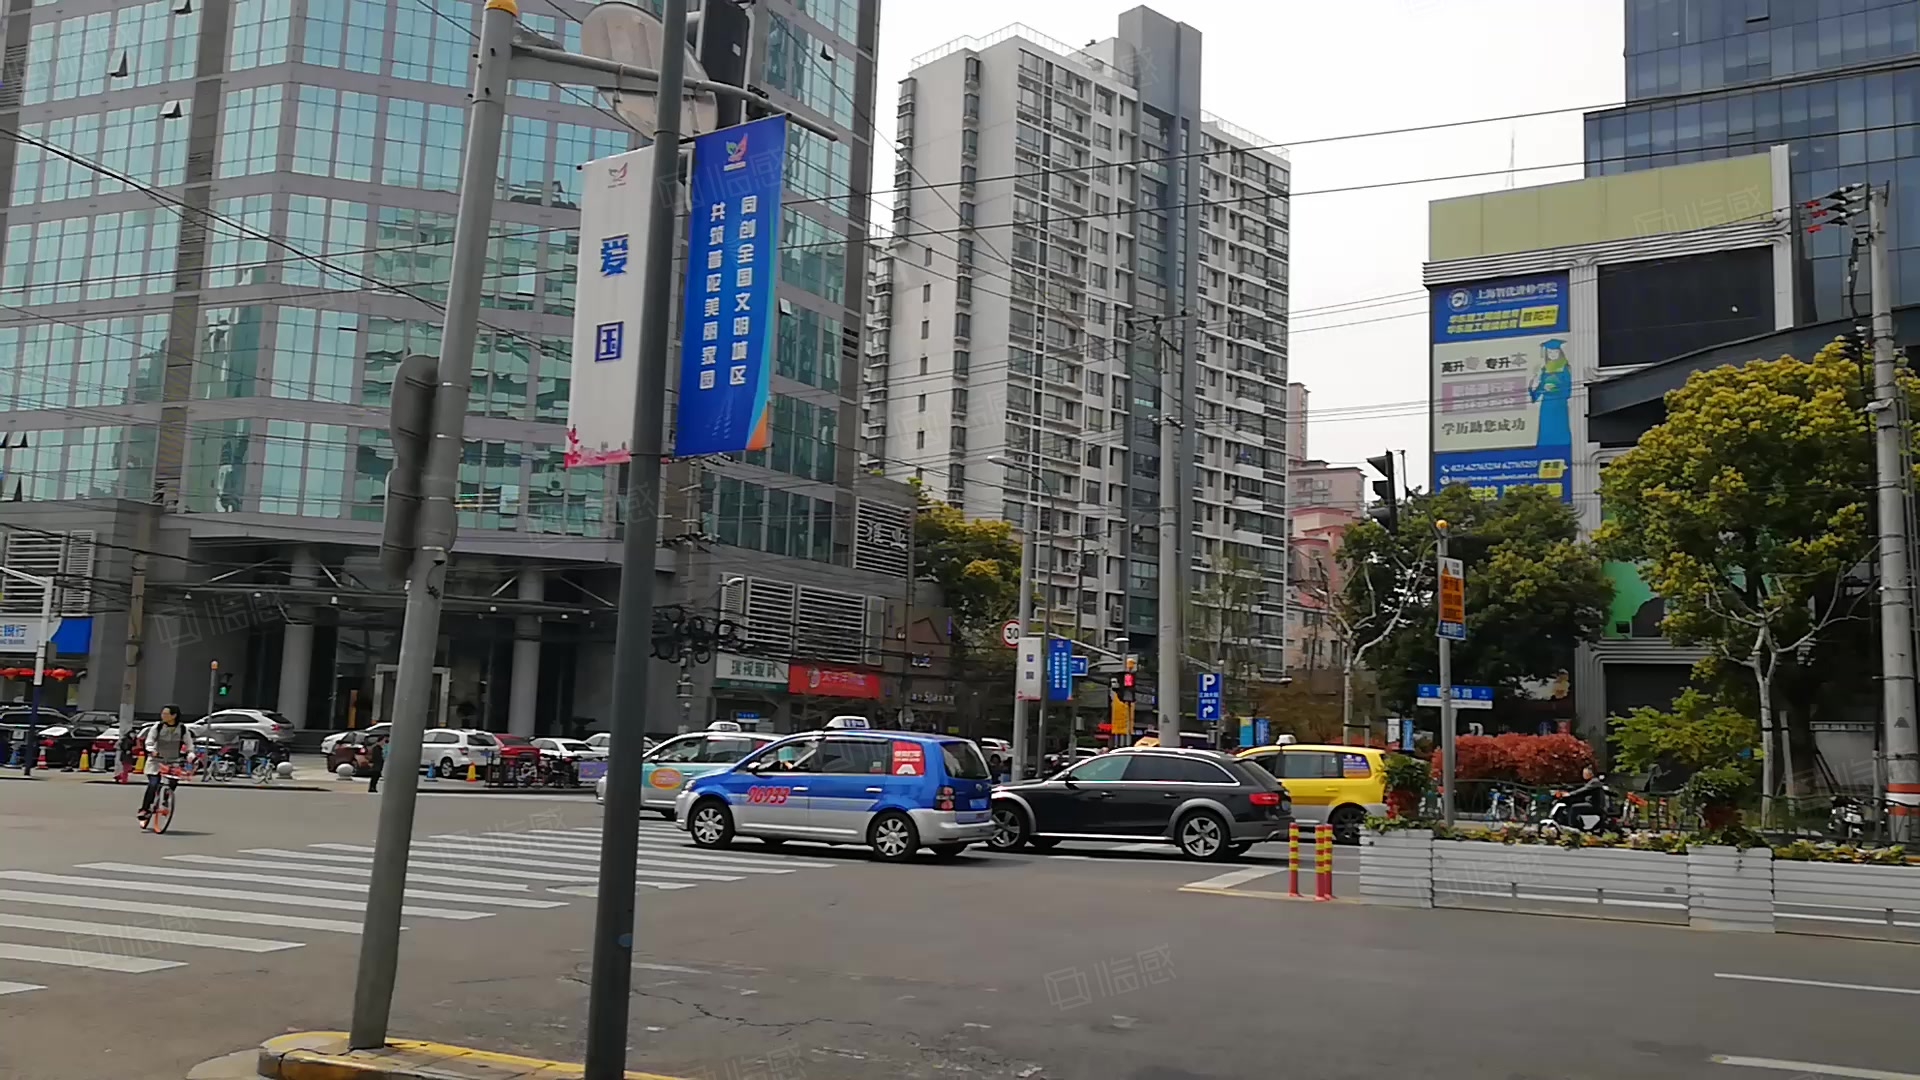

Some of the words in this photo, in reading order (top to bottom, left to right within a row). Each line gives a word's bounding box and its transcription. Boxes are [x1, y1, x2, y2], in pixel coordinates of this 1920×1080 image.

[594, 234, 629, 363] 爱国
[699, 201, 725, 390] 共筑普陀美丽家园
[729, 195, 758, 386] 同创全国文明城区
[1006, 627, 1020, 640] 30
[1202, 673, 1216, 692] P
